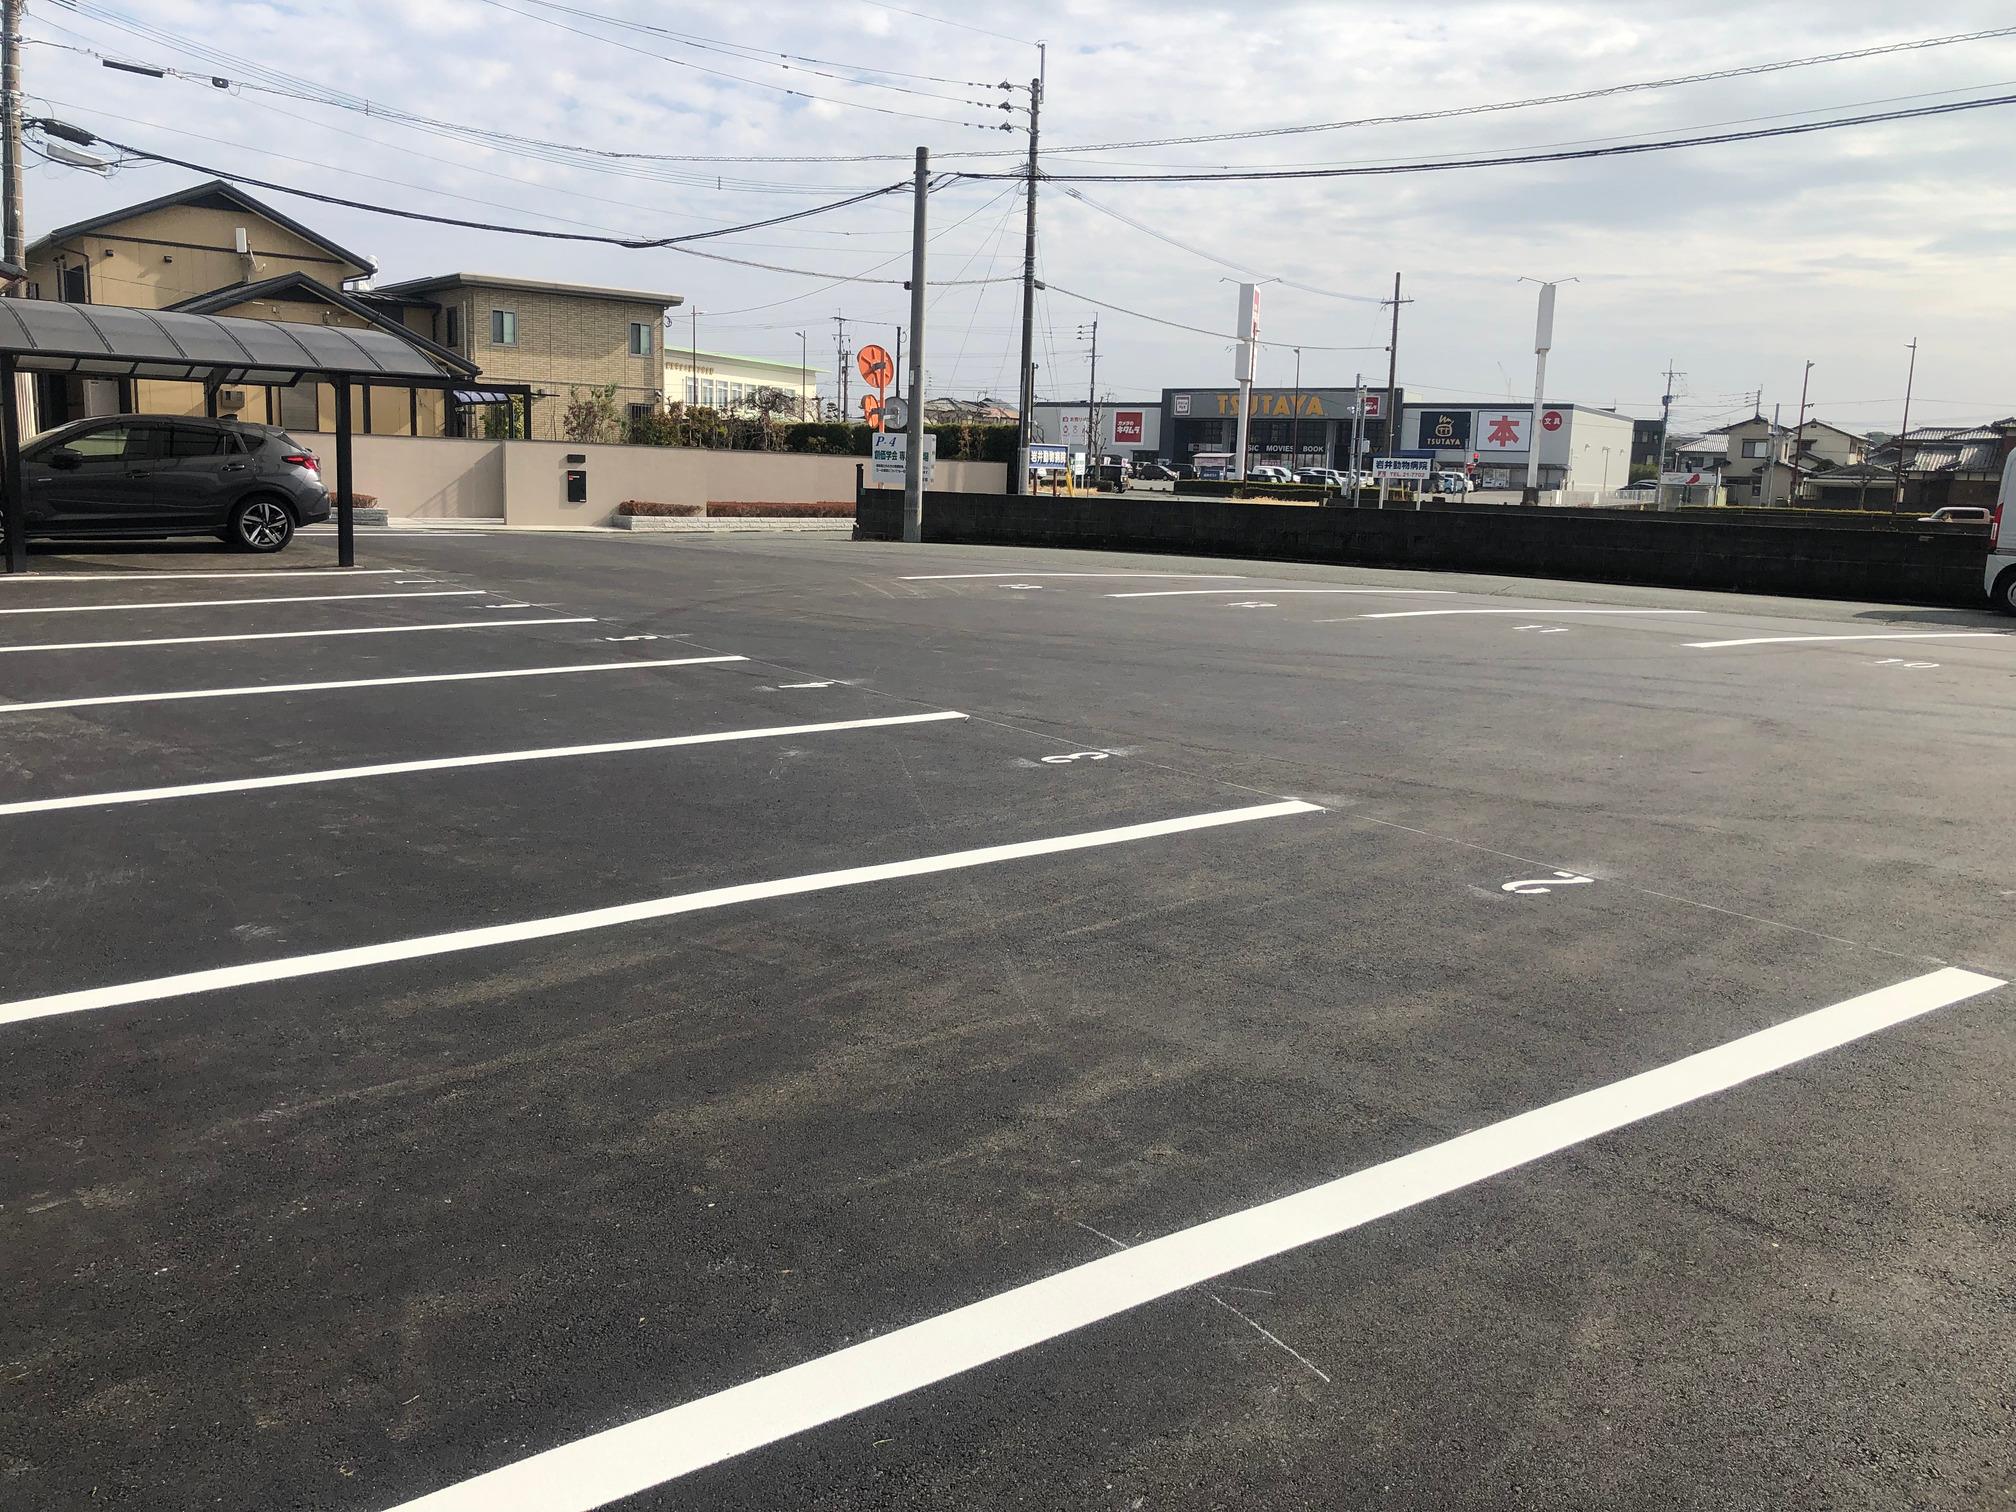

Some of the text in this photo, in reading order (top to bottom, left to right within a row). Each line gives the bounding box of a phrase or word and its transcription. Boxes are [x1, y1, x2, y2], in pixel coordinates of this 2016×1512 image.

[1216, 394, 1324, 416] TSUTAYA
[1544, 417, 1560, 425] 文具
[1116, 425, 1141, 434] キタムラ
[1487, 415, 1520, 447] 本
[1265, 444, 1295, 452] MOVIES
[1375, 460, 1428, 470] 岩井動物病院
[1040, 751, 1109, 764] 3
[1501, 870, 1595, 894] 2
